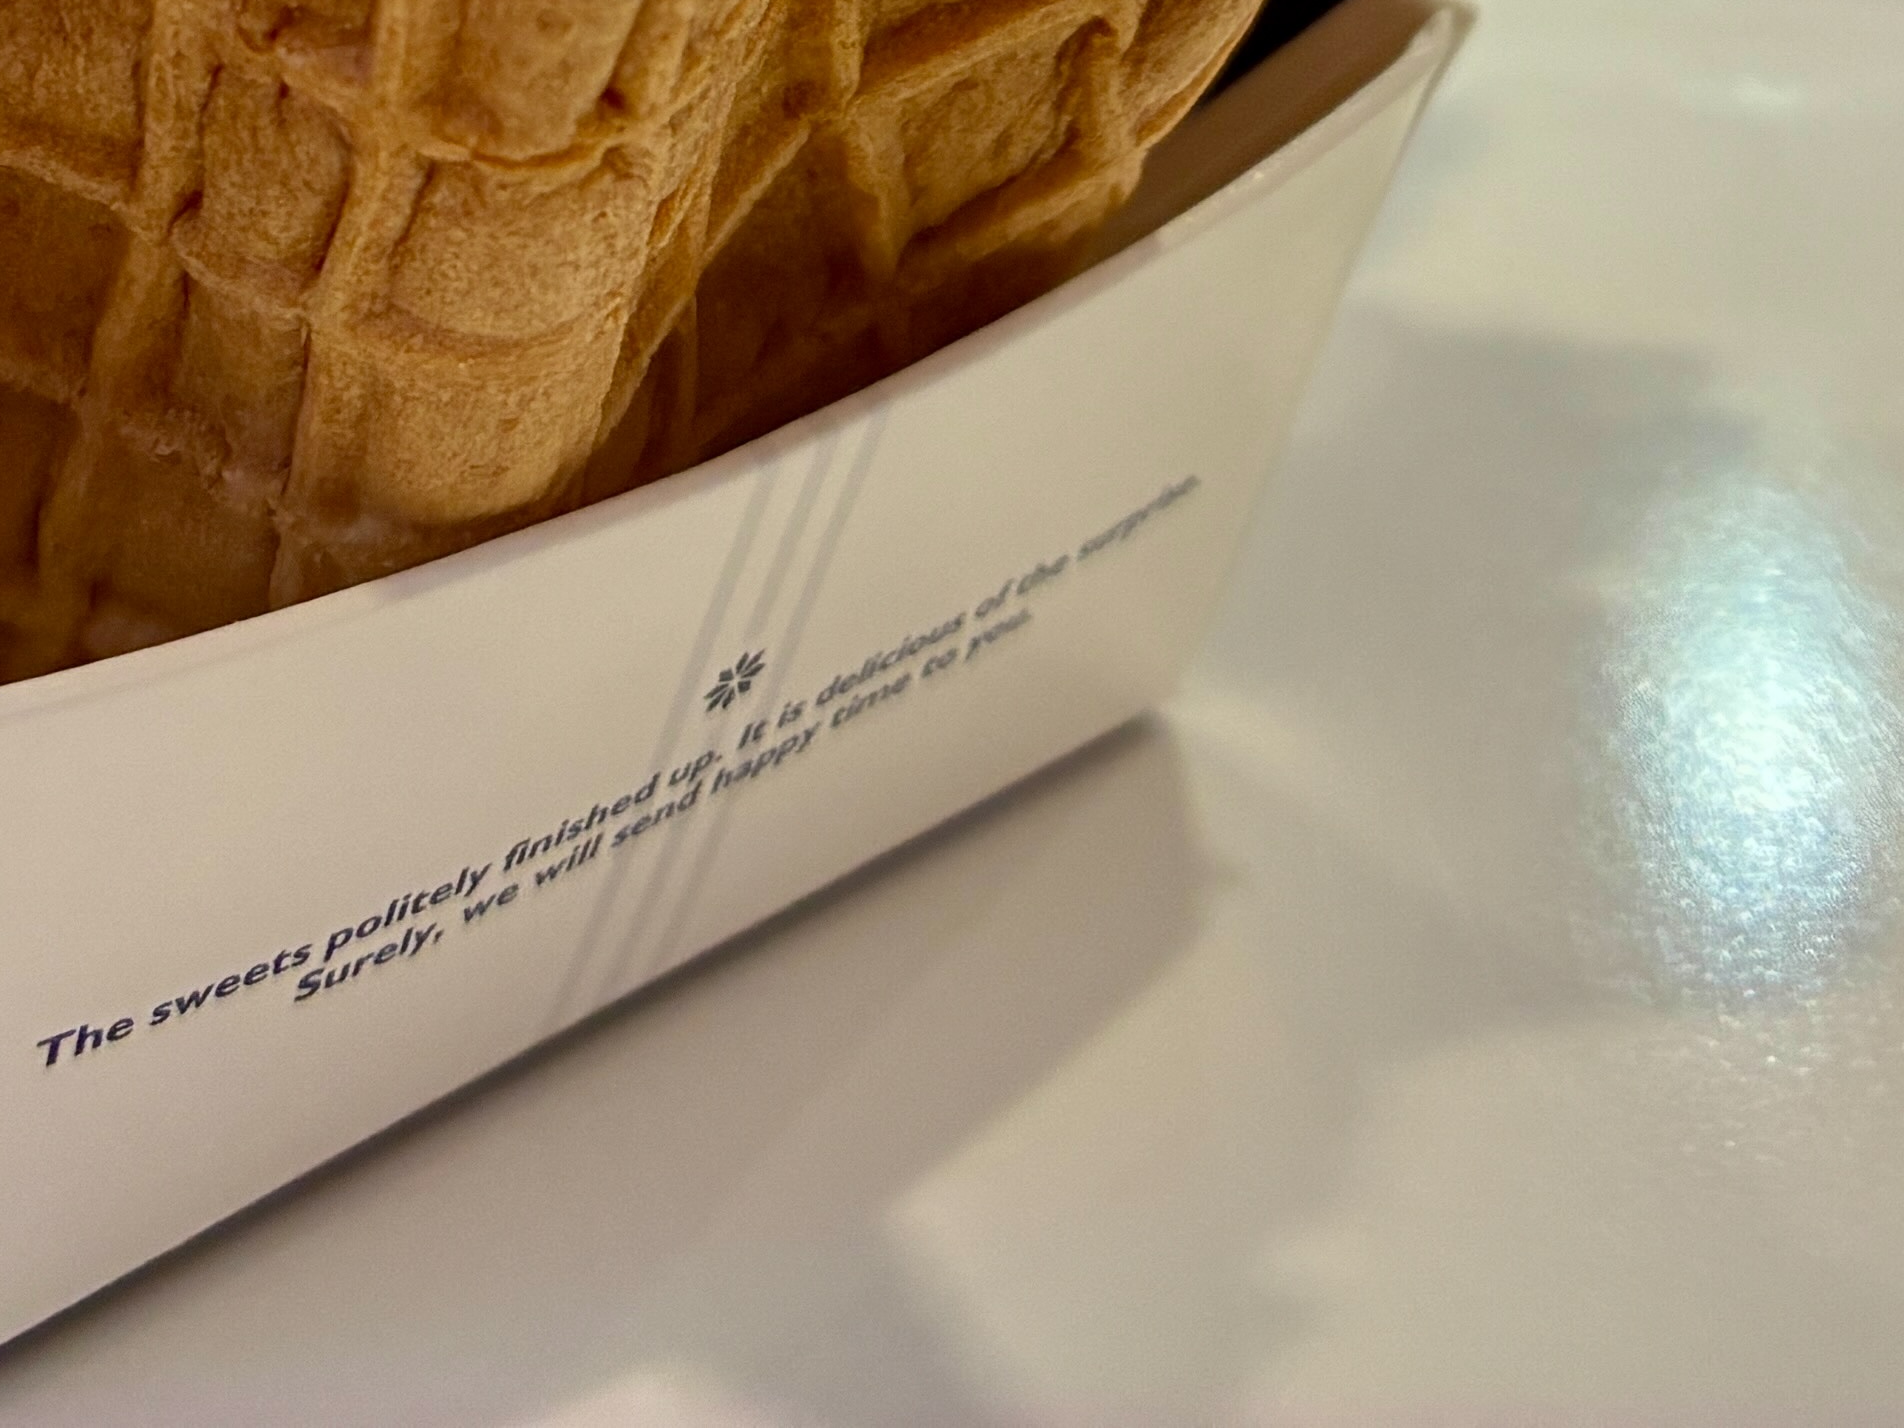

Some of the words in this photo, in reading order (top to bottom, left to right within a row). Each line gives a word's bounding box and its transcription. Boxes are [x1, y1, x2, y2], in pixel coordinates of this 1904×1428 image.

[35, 1016, 135, 1068] The
[148, 942, 313, 1027] sweets
[323, 862, 492, 961] politely
[502, 770, 661, 872] finished
[667, 748, 723, 788] up.
[737, 718, 768, 750] It
[776, 699, 807, 729] is
[815, 611, 967, 707] delicious
[974, 577, 1015, 620] of
[293, 920, 445, 1003] Surely,
[462, 881, 520, 925] we
[534, 832, 604, 887] will
[609, 777, 704, 848] send
[710, 720, 822, 795] happy
[830, 673, 912, 729] time
